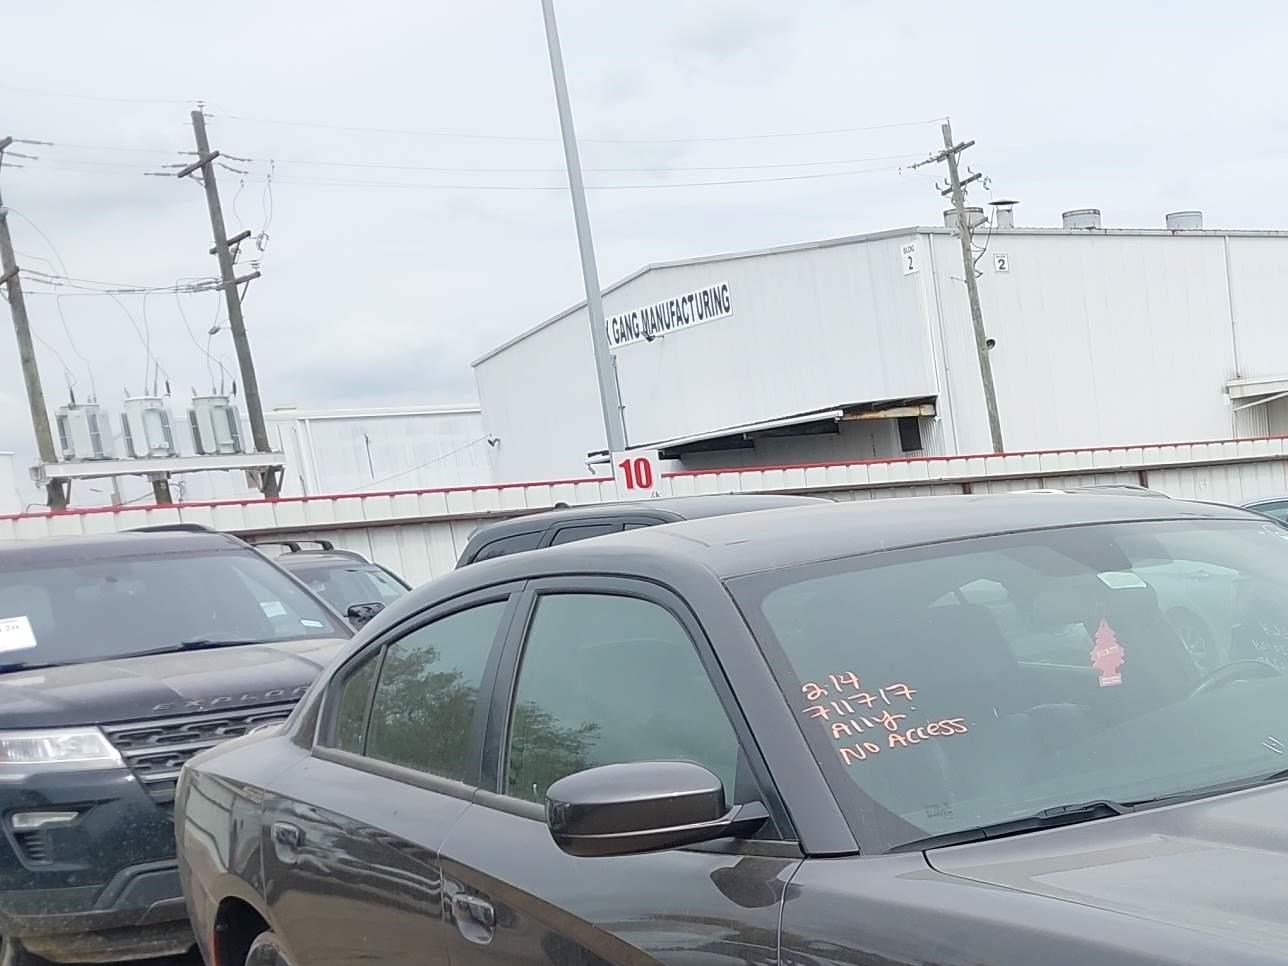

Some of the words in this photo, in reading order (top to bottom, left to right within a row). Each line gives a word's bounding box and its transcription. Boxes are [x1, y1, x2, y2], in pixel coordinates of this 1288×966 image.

[908, 256, 914, 270] 2
[998, 259, 1006, 270] 2
[612, 312, 640, 345] GANG
[640, 283, 731, 335] MANUFACTURING
[619, 457, 653, 489] 10
